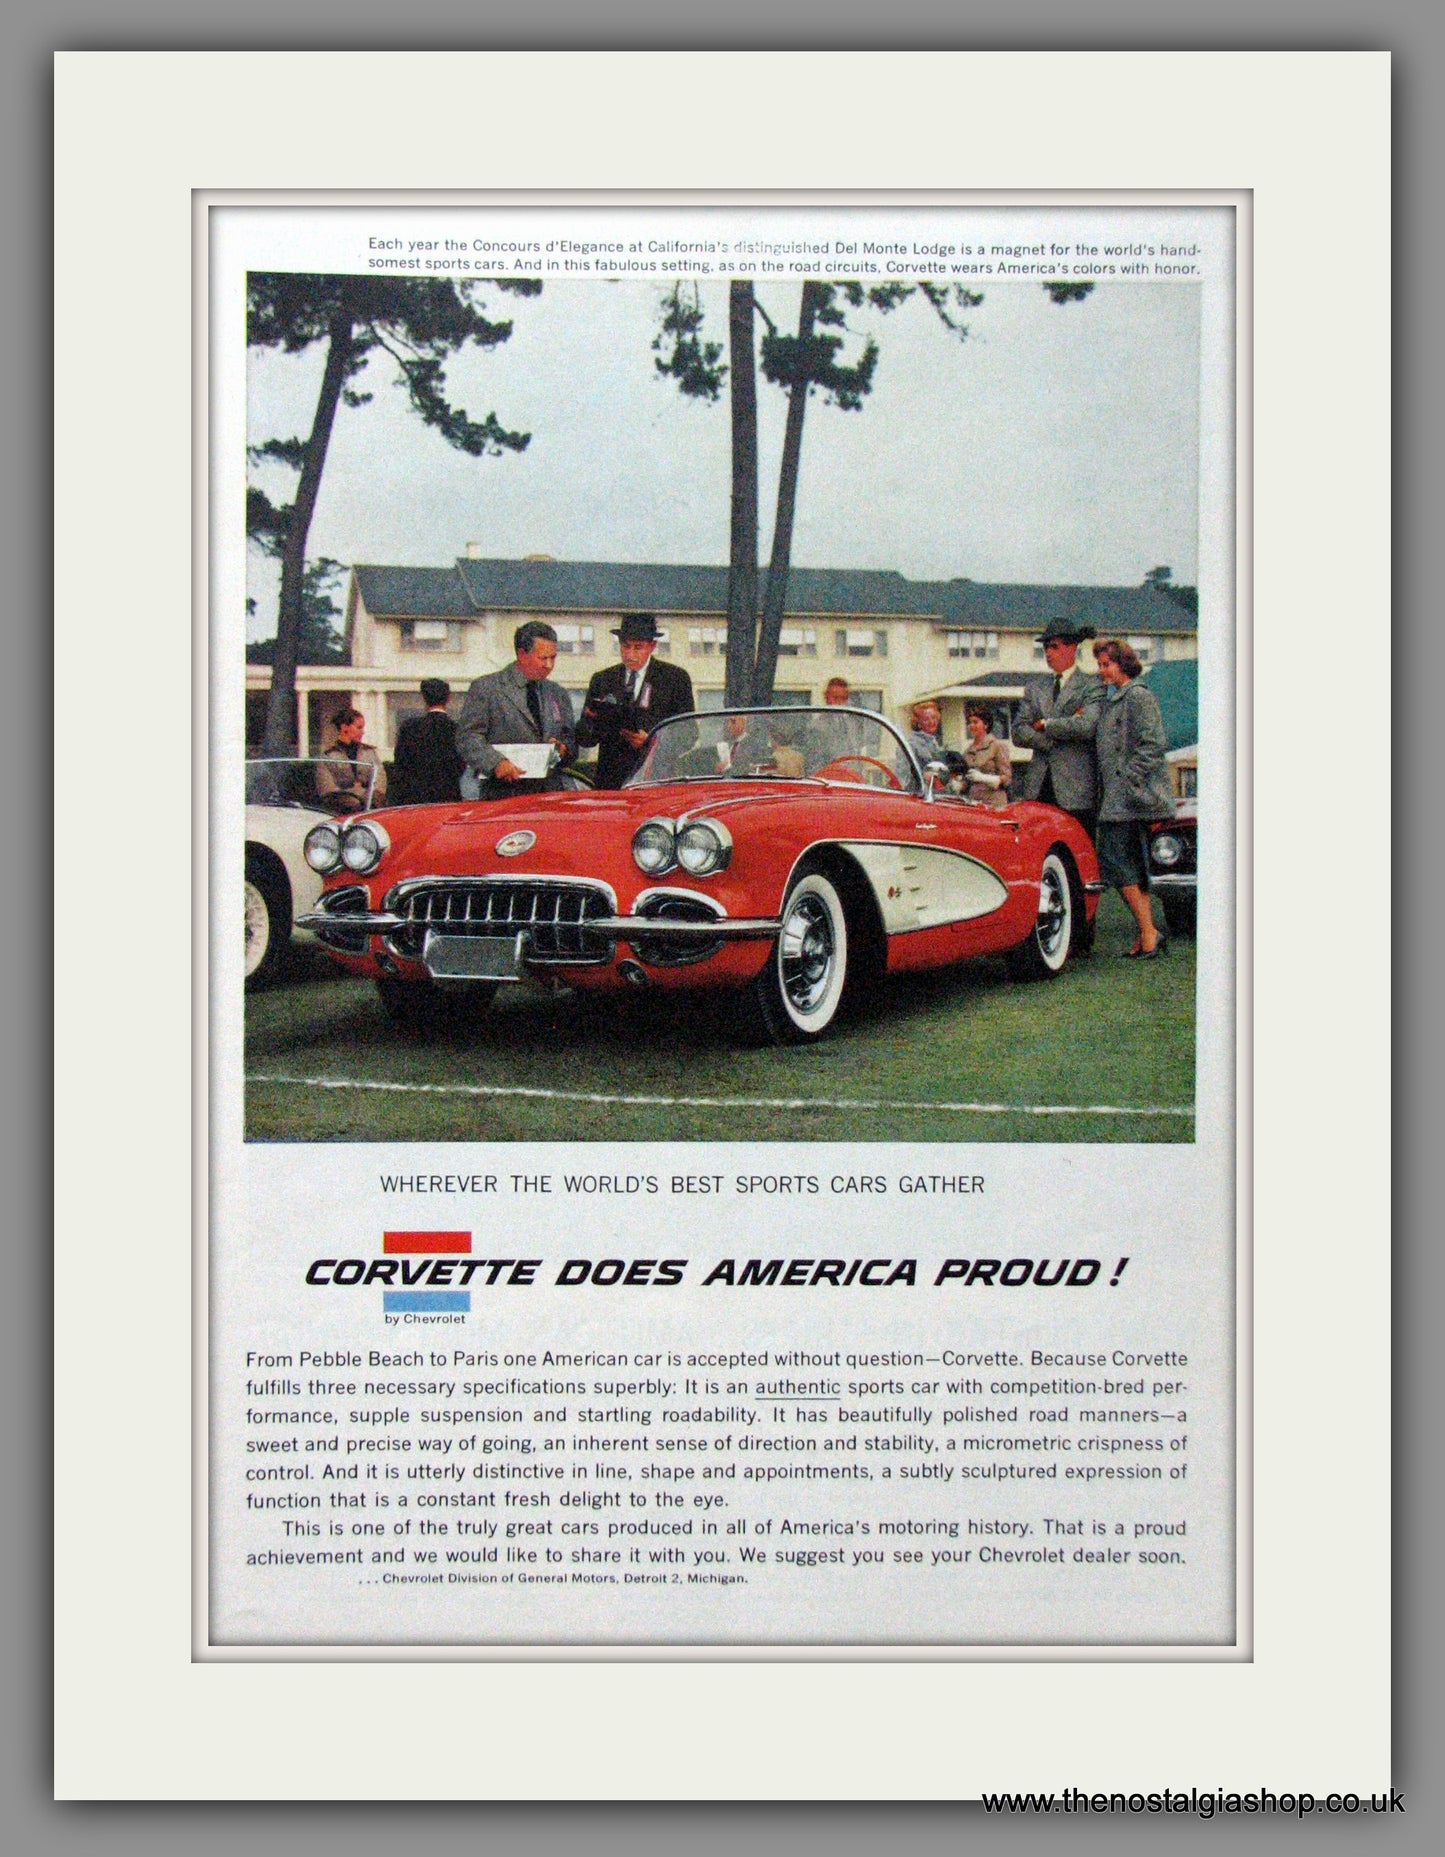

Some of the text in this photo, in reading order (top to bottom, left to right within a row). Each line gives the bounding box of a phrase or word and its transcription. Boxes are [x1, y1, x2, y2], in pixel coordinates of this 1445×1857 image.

[368, 236, 403, 250] Each
[408, 240, 440, 253] year
[444, 239, 468, 251] the
[472, 238, 541, 253] Concours
[545, 240, 624, 255] d'Elegance
[628, 241, 643, 253] at
[647, 240, 729, 254] California's
[733, 240, 830, 257] distinguished
[835, 241, 858, 255] Del
[862, 242, 908, 255] Monte
[912, 242, 956, 258] Lodge
[960, 243, 973, 256] is
[977, 245, 986, 256] a
[990, 243, 1046, 258] magnet
[1049, 243, 1071, 256] for
[1075, 243, 1099, 256] the
[1103, 243, 1156, 256] world's
[368, 257, 1200, 275] somest sports cars. And in this fabulous setting, as on the road circuits, Corvette wears America's colors with honor.
[379, 1174, 985, 1194] WHEREVER THE WORLD'S BEST SPORTS CARS GATHER
[304, 1258, 544, 1287] CORVETTE
[553, 1258, 690, 1287] DOES
[700, 1258, 918, 1287] AMERICA
[384, 1313, 466, 1326] by Chevrolet
[245, 1351, 293, 1368] From
[299, 1350, 362, 1368] Pebble
[368, 1350, 424, 1368] Beach
[429, 1351, 448, 1367] to
[453, 1350, 499, 1367] Paris
[503, 1354, 537, 1367] one
[541, 1350, 629, 1367] American
[633, 1354, 663, 1367] car
[667, 1350, 682, 1367] is
[686, 1350, 769, 1370] accepted
[774, 1350, 841, 1367] without
[1030, 1349, 1107, 1367] Because
[1111, 1349, 1188, 1367] Corvette
[245, 1407, 339, 1425] formance,
[349, 1406, 410, 1427] supple
[420, 1410, 523, 1426] suspension
[533, 1406, 567, 1423] and
[577, 1406, 652, 1427] startling
[662, 1406, 761, 1427] roadability.
[773, 1406, 786, 1423] It
[796, 1407, 828, 1423] has
[838, 1406, 933, 1427] beautifully
[942, 1406, 1018, 1426] polished
[1029, 1406, 1069, 1423] road
[245, 1434, 1188, 1455] sweet and precise way of going, an inherent sense of direction and stability, a micrometric crispness of
[245, 1490, 729, 1511] function that is a constant fresh delight to the eye.
[282, 1518, 1187, 1539] This is one of the truly great cars produced in all of America's motoring history. That is a proud
[246, 1545, 1186, 1567] achievement and we would like to share it with you. We suggest you see your Chevrolet dealer soon.
[382, 1572, 444, 1584] Chevrolet
[447, 1572, 498, 1584] Division
[501, 1572, 514, 1584] of
[517, 1572, 568, 1584] General
[571, 1572, 620, 1585] Motors,
[623, 1573, 667, 1584] Detroit
[671, 1573, 683, 1585] 2,
[687, 1573, 748, 1586] Michigan.
